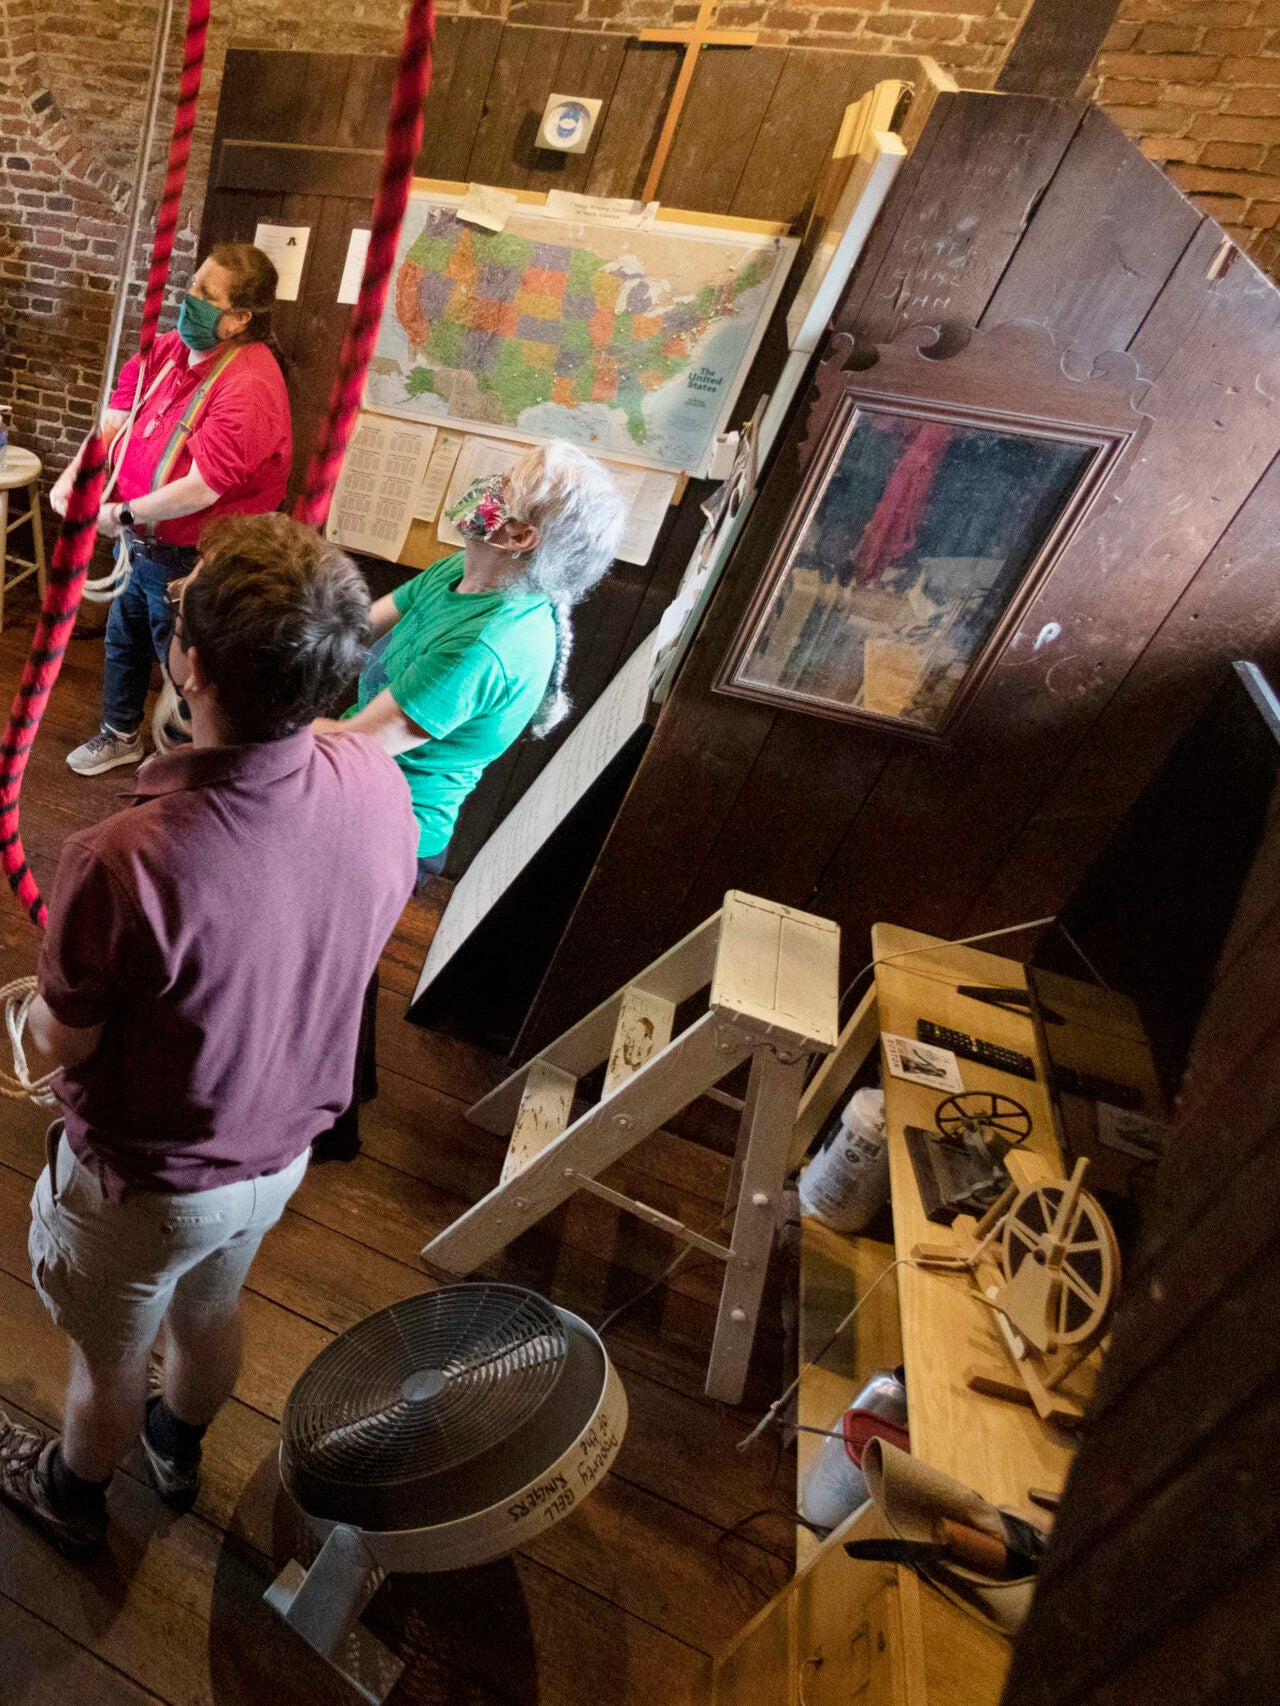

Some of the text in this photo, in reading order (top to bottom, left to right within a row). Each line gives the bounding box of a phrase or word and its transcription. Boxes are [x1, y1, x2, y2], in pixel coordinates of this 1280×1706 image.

[688, 372, 723, 386] United
[701, 367, 716, 377] The
[687, 380, 717, 393] States
[580, 1428, 598, 1456] the
[577, 1432, 619, 1486] Property
[507, 1473, 568, 1523] RINGERS
